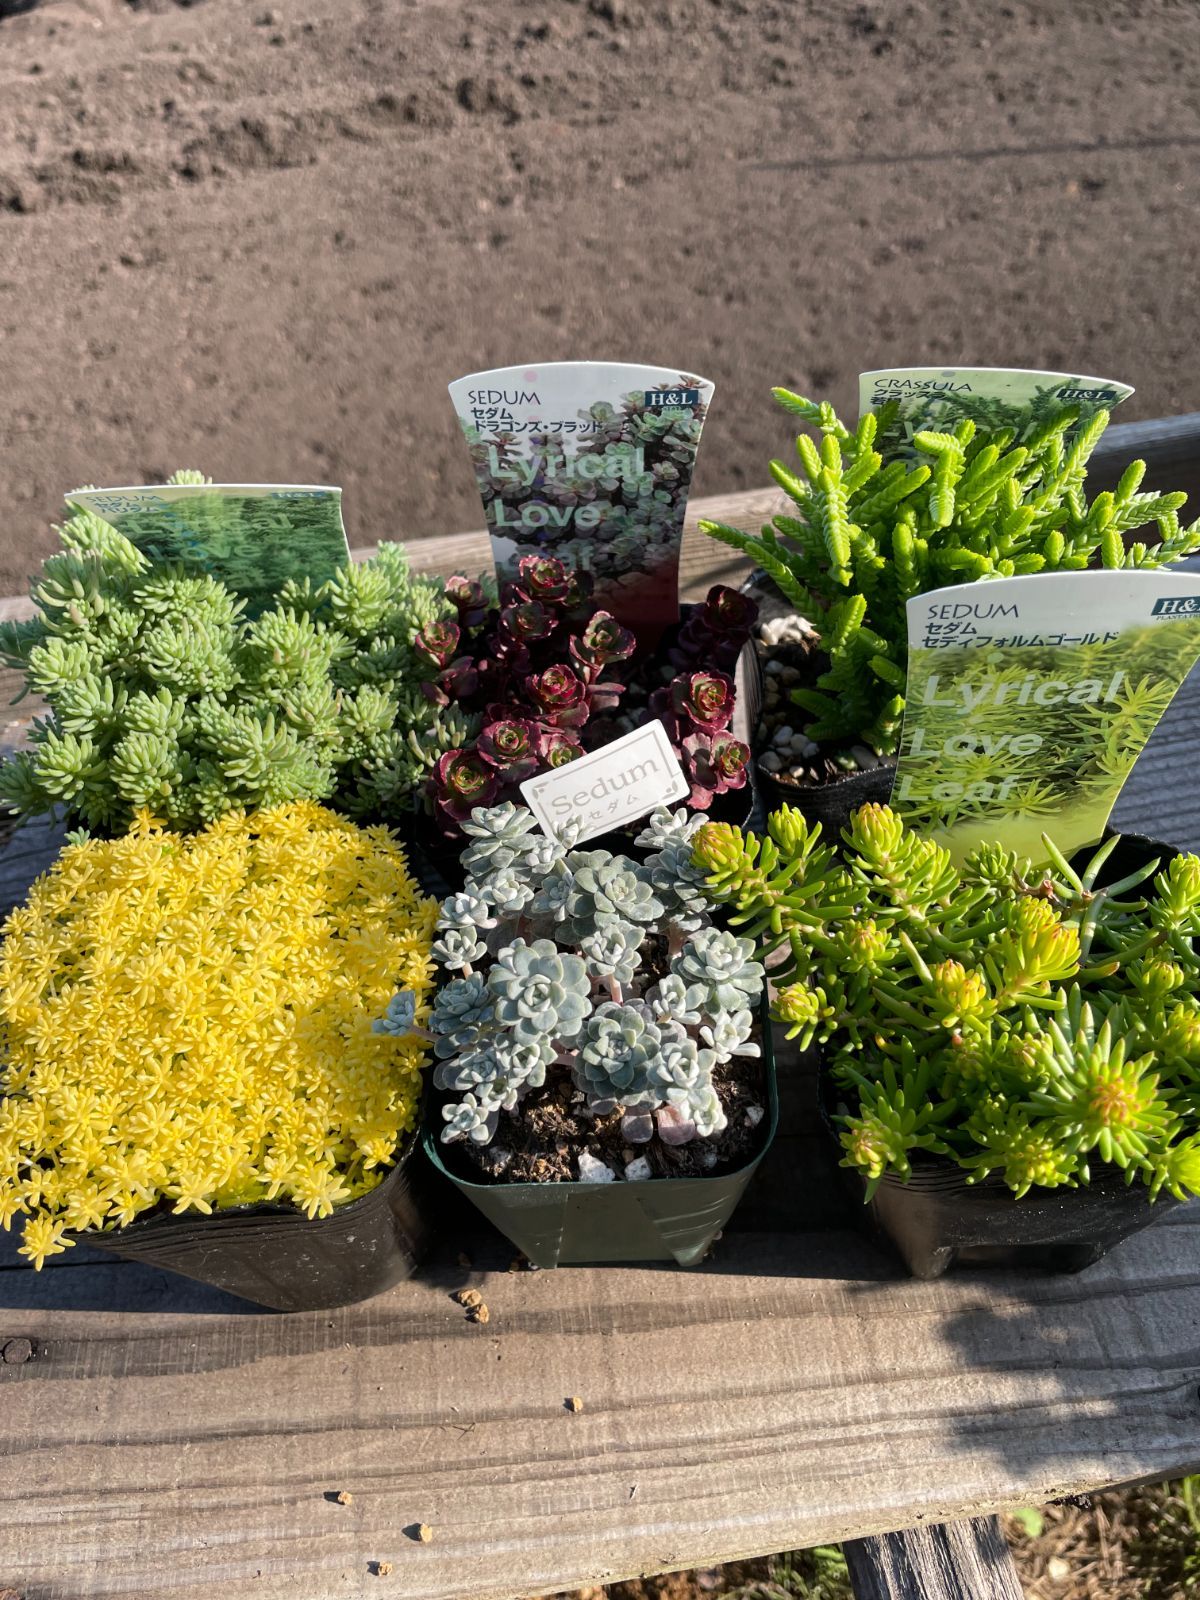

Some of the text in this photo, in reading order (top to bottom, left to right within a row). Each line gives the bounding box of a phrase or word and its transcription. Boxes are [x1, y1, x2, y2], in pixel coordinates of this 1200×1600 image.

[874, 378, 972, 392] CRASSULA
[468, 390, 541, 405] SEDUM
[650, 392, 693, 406] H&L
[874, 389, 946, 399] クラッスラ
[1062, 389, 1107, 400] H&L
[471, 407, 513, 420] セダム
[474, 420, 603, 433] ドラゴンズ・ブラッド
[488, 446, 645, 486] Lyrical
[85, 495, 165, 503] SEDUM
[494, 499, 601, 527] Love
[146, 545, 262, 561] Love
[928, 603, 1019, 619] SEDUM
[1157, 598, 1200, 614] H&
[924, 622, 977, 636] セダム
[921, 631, 1120, 649] セディフォルムゴールド
[922, 671, 1126, 714] Lyrical
[909, 728, 1045, 758] Love
[552, 758, 660, 816] Sedum
[898, 775, 1020, 802] Leaf
[588, 794, 641, 820] セダム
